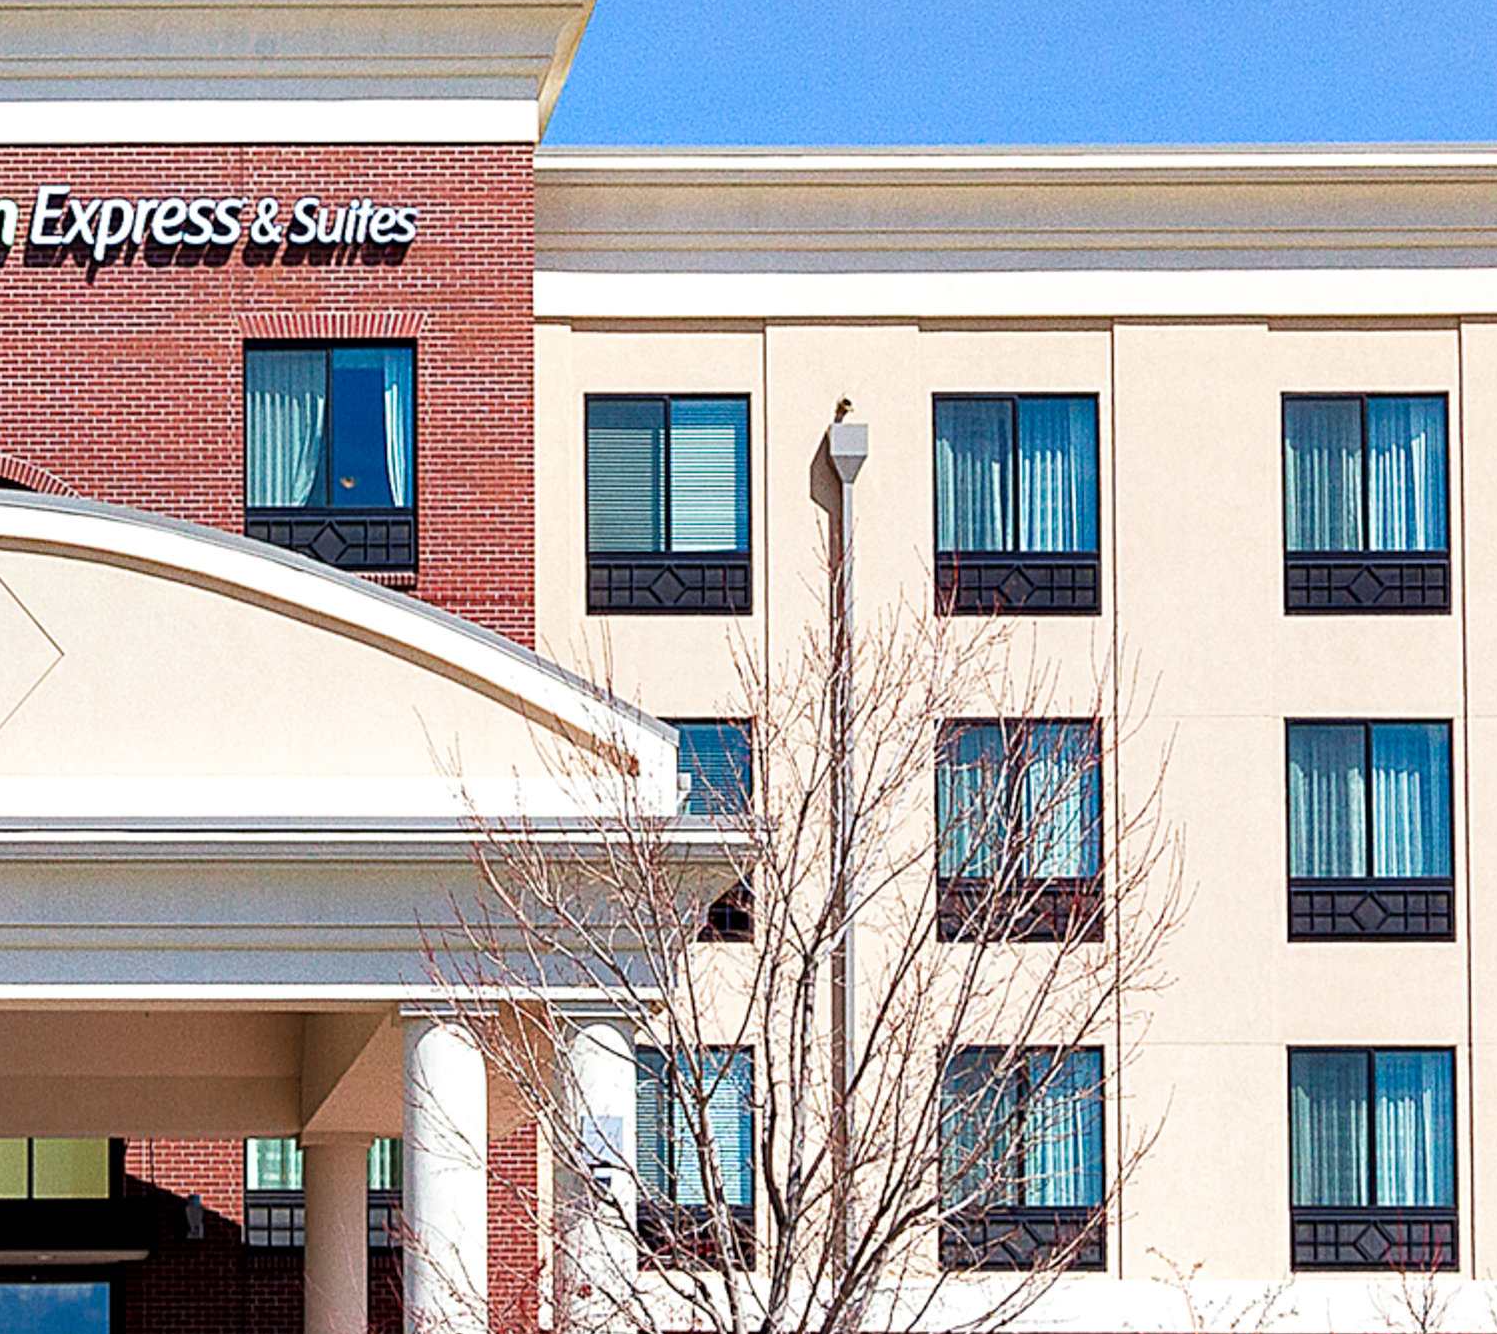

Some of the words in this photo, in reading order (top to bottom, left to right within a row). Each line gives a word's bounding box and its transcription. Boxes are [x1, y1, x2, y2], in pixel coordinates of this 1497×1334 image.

[29, 184, 244, 262] Express
[250, 196, 284, 244] &
[289, 196, 419, 244] Suites
